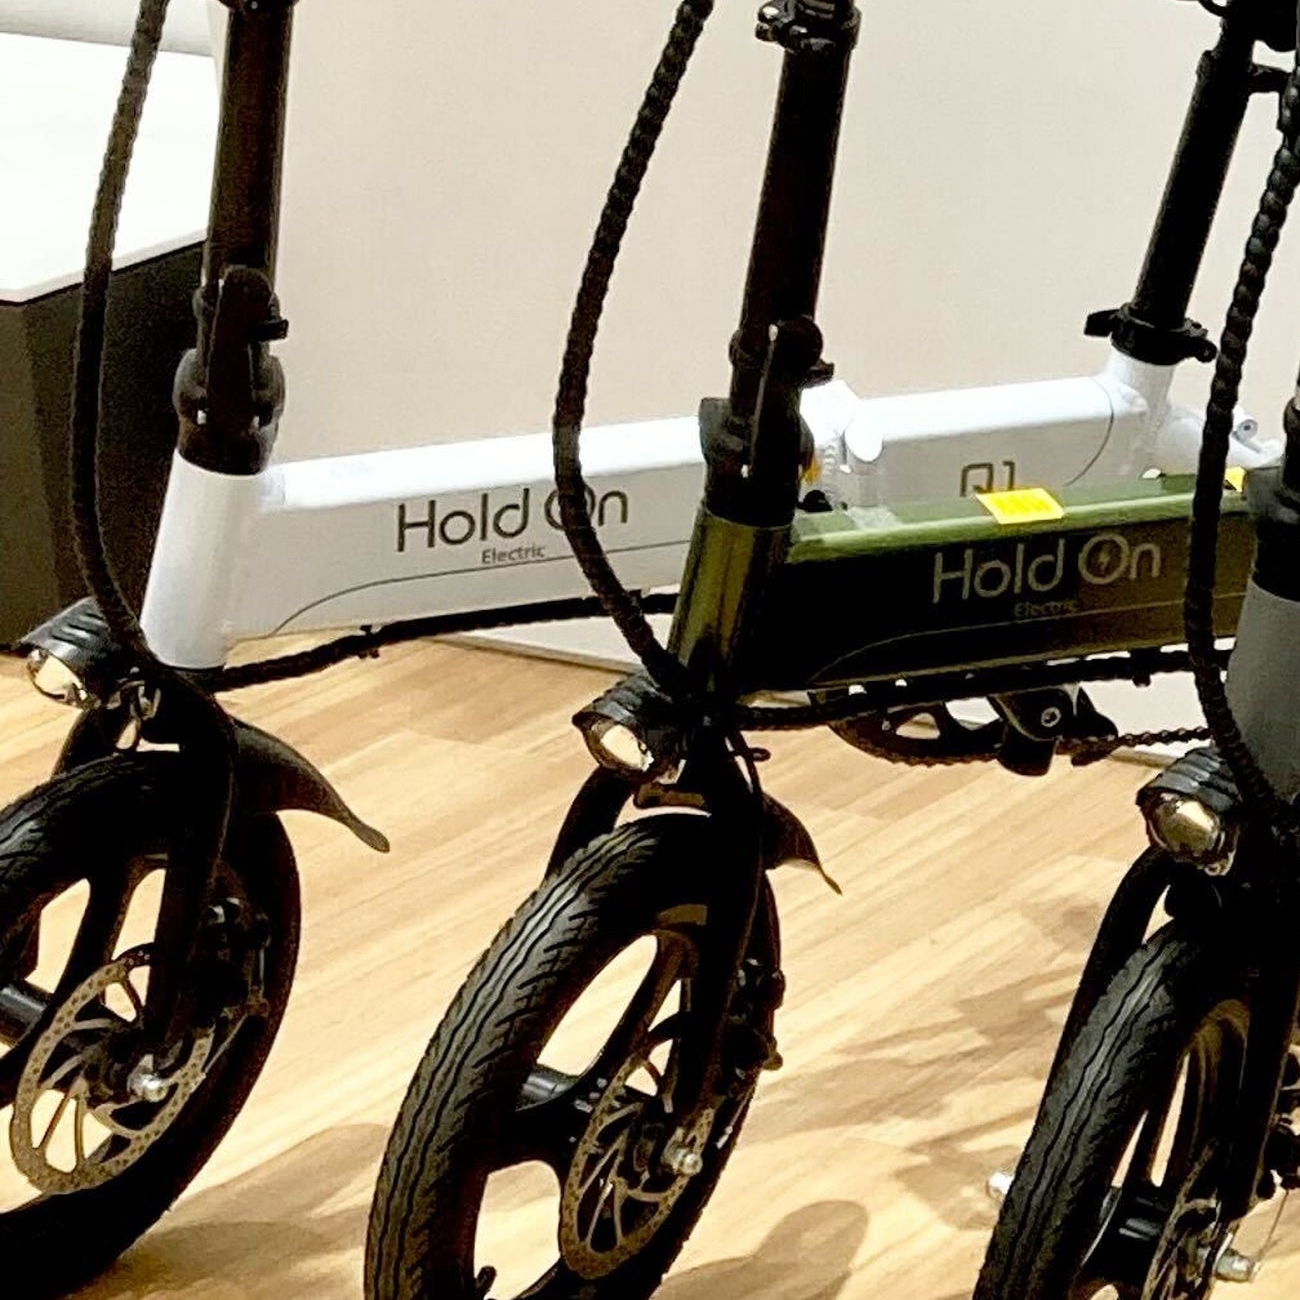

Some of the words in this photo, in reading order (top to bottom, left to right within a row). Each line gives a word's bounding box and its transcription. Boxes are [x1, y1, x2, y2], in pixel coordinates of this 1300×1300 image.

[396, 487, 530, 552] Hold
[481, 543, 547, 565] Electric
[931, 538, 1066, 604] Hold
[1077, 532, 1162, 585] On
